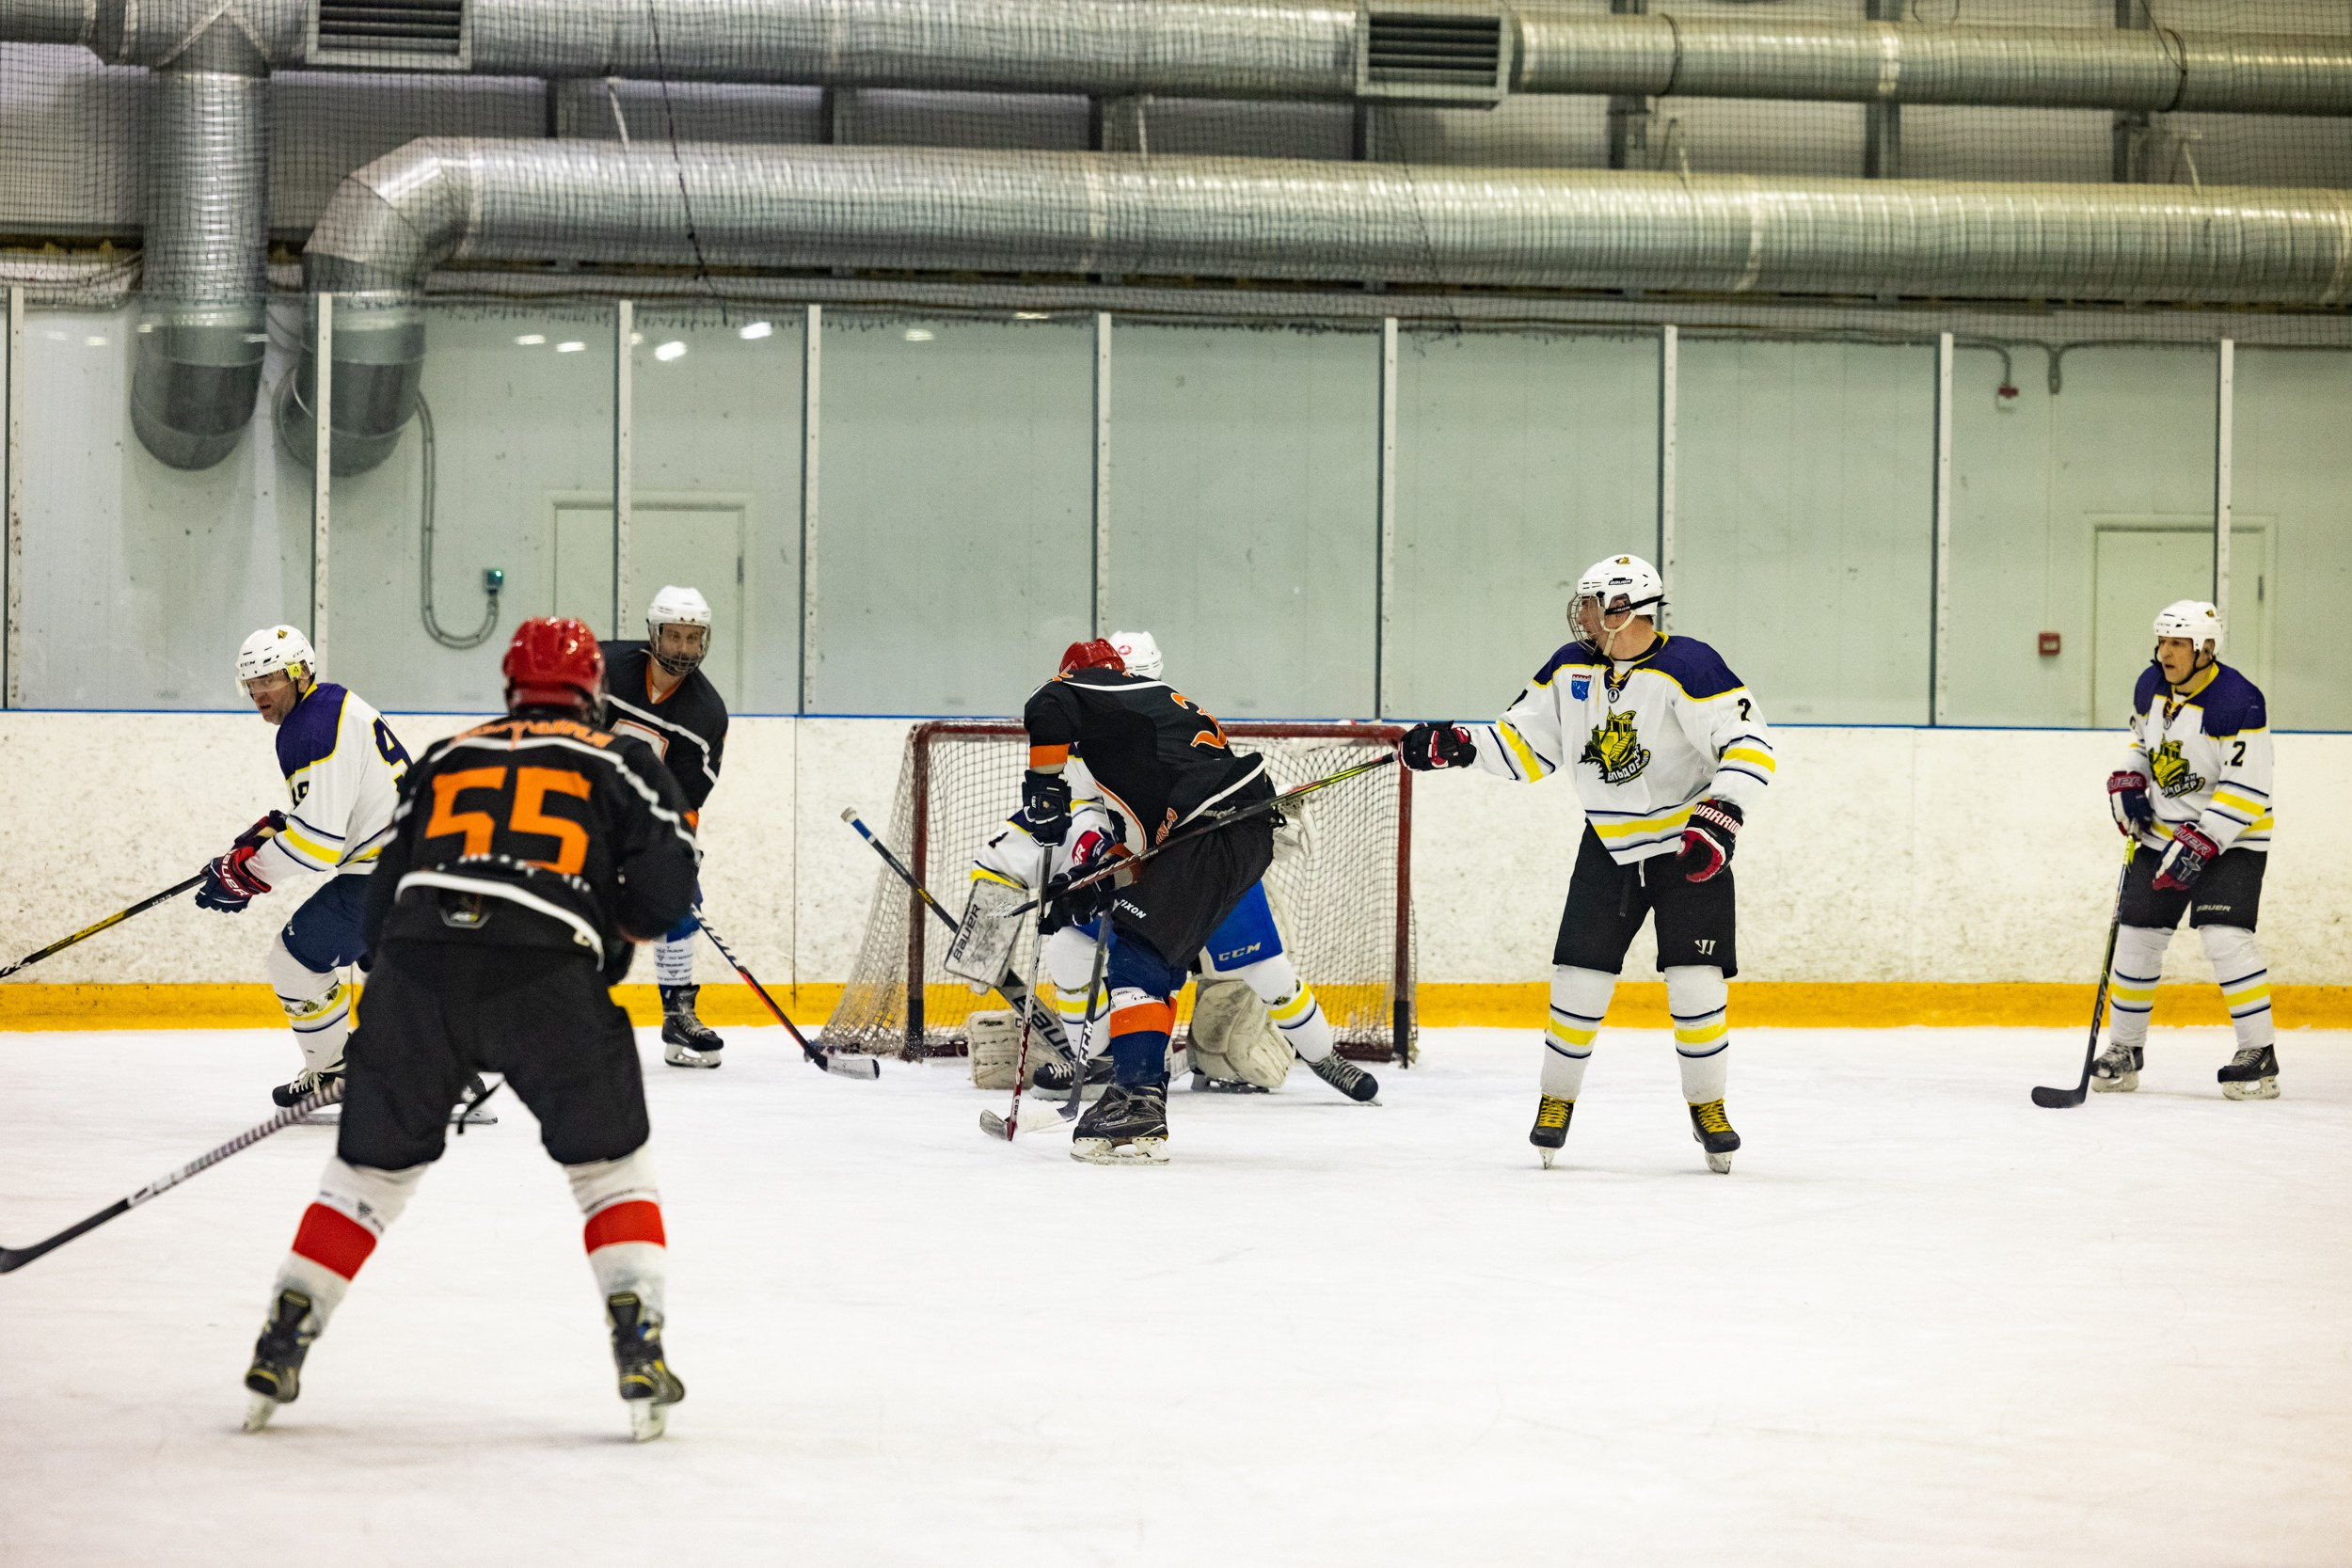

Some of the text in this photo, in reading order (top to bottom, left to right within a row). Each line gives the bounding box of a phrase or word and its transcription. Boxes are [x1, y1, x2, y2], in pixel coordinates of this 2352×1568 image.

[425, 766, 592, 875] 55
[953, 903, 981, 962] BAUER
[1218, 942, 1261, 961] CCM
[1011, 995, 1077, 1063] BAUE
[1078, 1019, 1093, 1067] CCM
